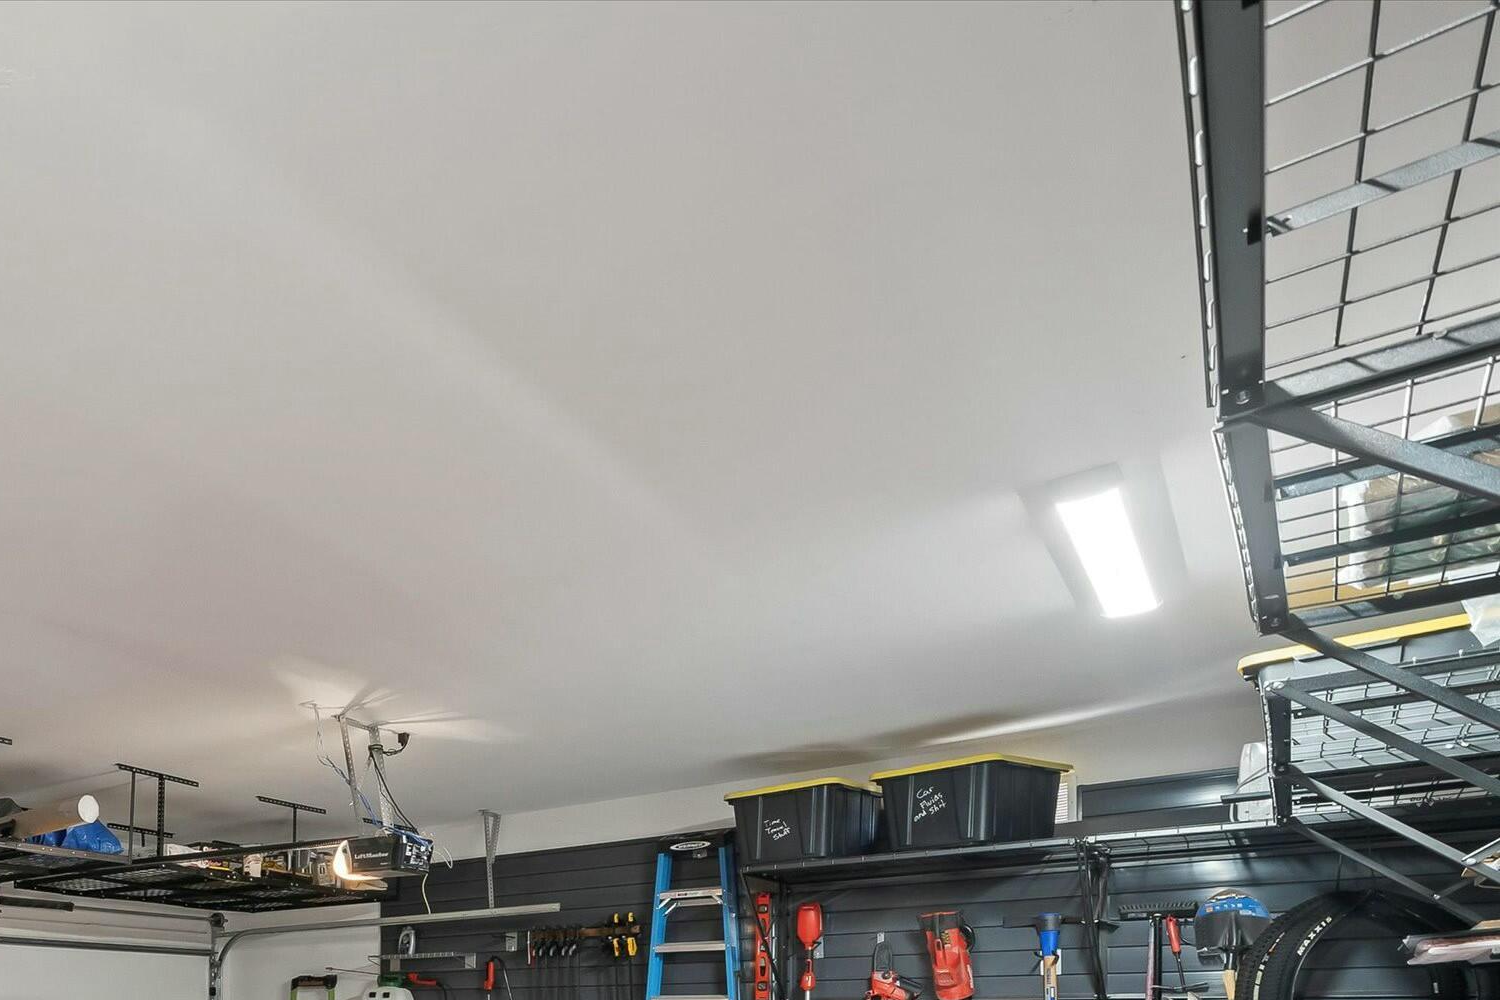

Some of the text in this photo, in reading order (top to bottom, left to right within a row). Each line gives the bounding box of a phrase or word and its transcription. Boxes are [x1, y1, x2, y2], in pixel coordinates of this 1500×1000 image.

[916, 786, 934, 799] Car
[920, 792, 943, 809] Fluids
[913, 810, 927, 822] and
[1297, 916, 1333, 956] MAXXIS
